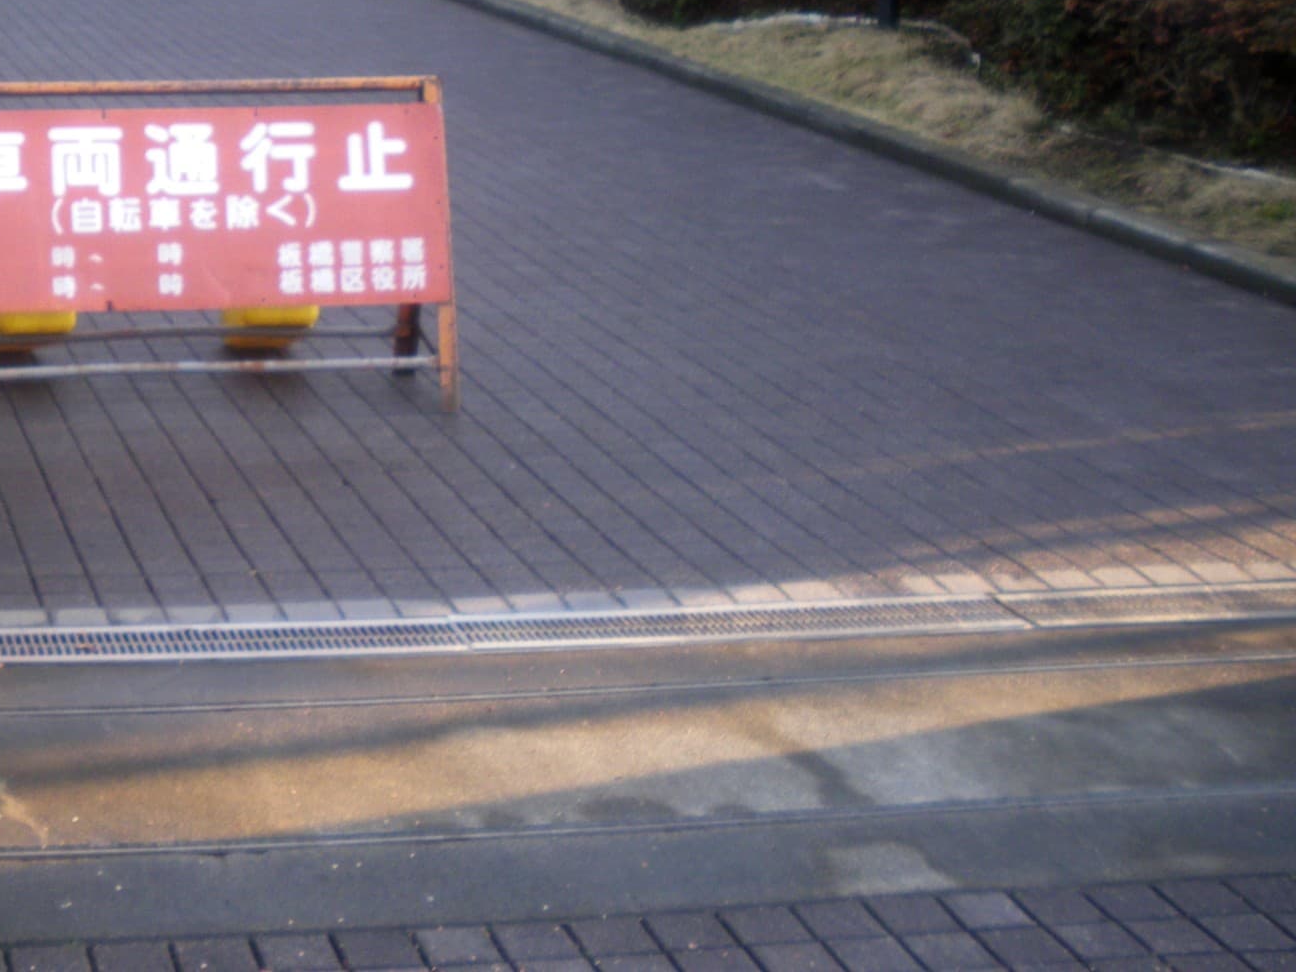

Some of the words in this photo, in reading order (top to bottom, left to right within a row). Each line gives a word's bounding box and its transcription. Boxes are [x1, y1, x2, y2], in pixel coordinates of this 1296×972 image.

[52, 194, 316, 235] (自転車を除く)
[279, 265, 426, 294] 板橋区役所
